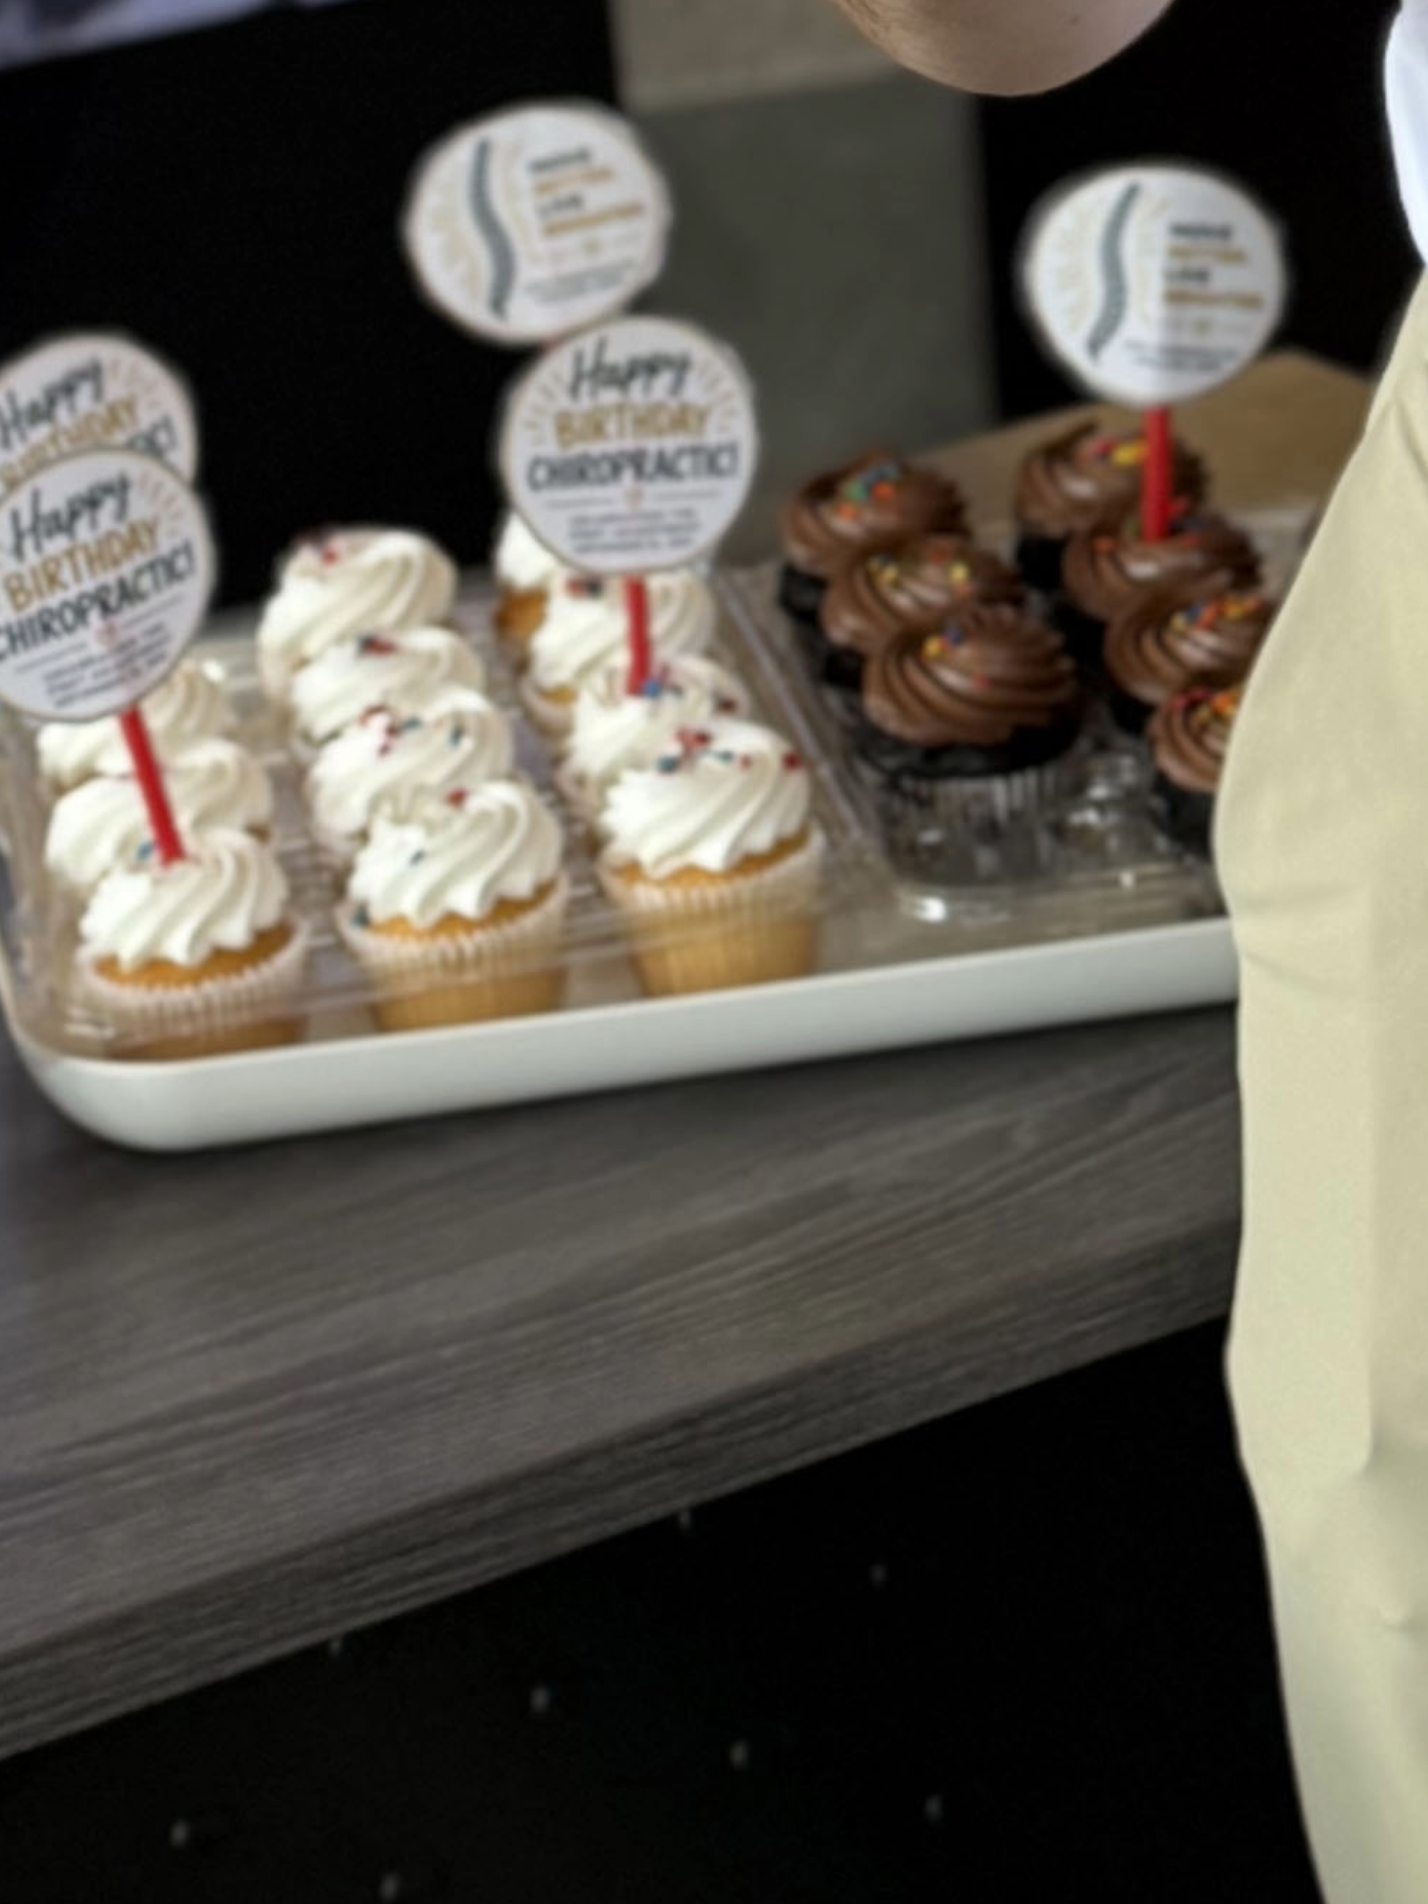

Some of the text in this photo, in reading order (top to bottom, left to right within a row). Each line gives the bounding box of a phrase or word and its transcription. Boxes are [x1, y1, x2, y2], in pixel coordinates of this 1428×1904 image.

[568, 335, 690, 402] Happy
[10, 469, 132, 562] Happy
[3, 517, 159, 613] BIRTHDAY
